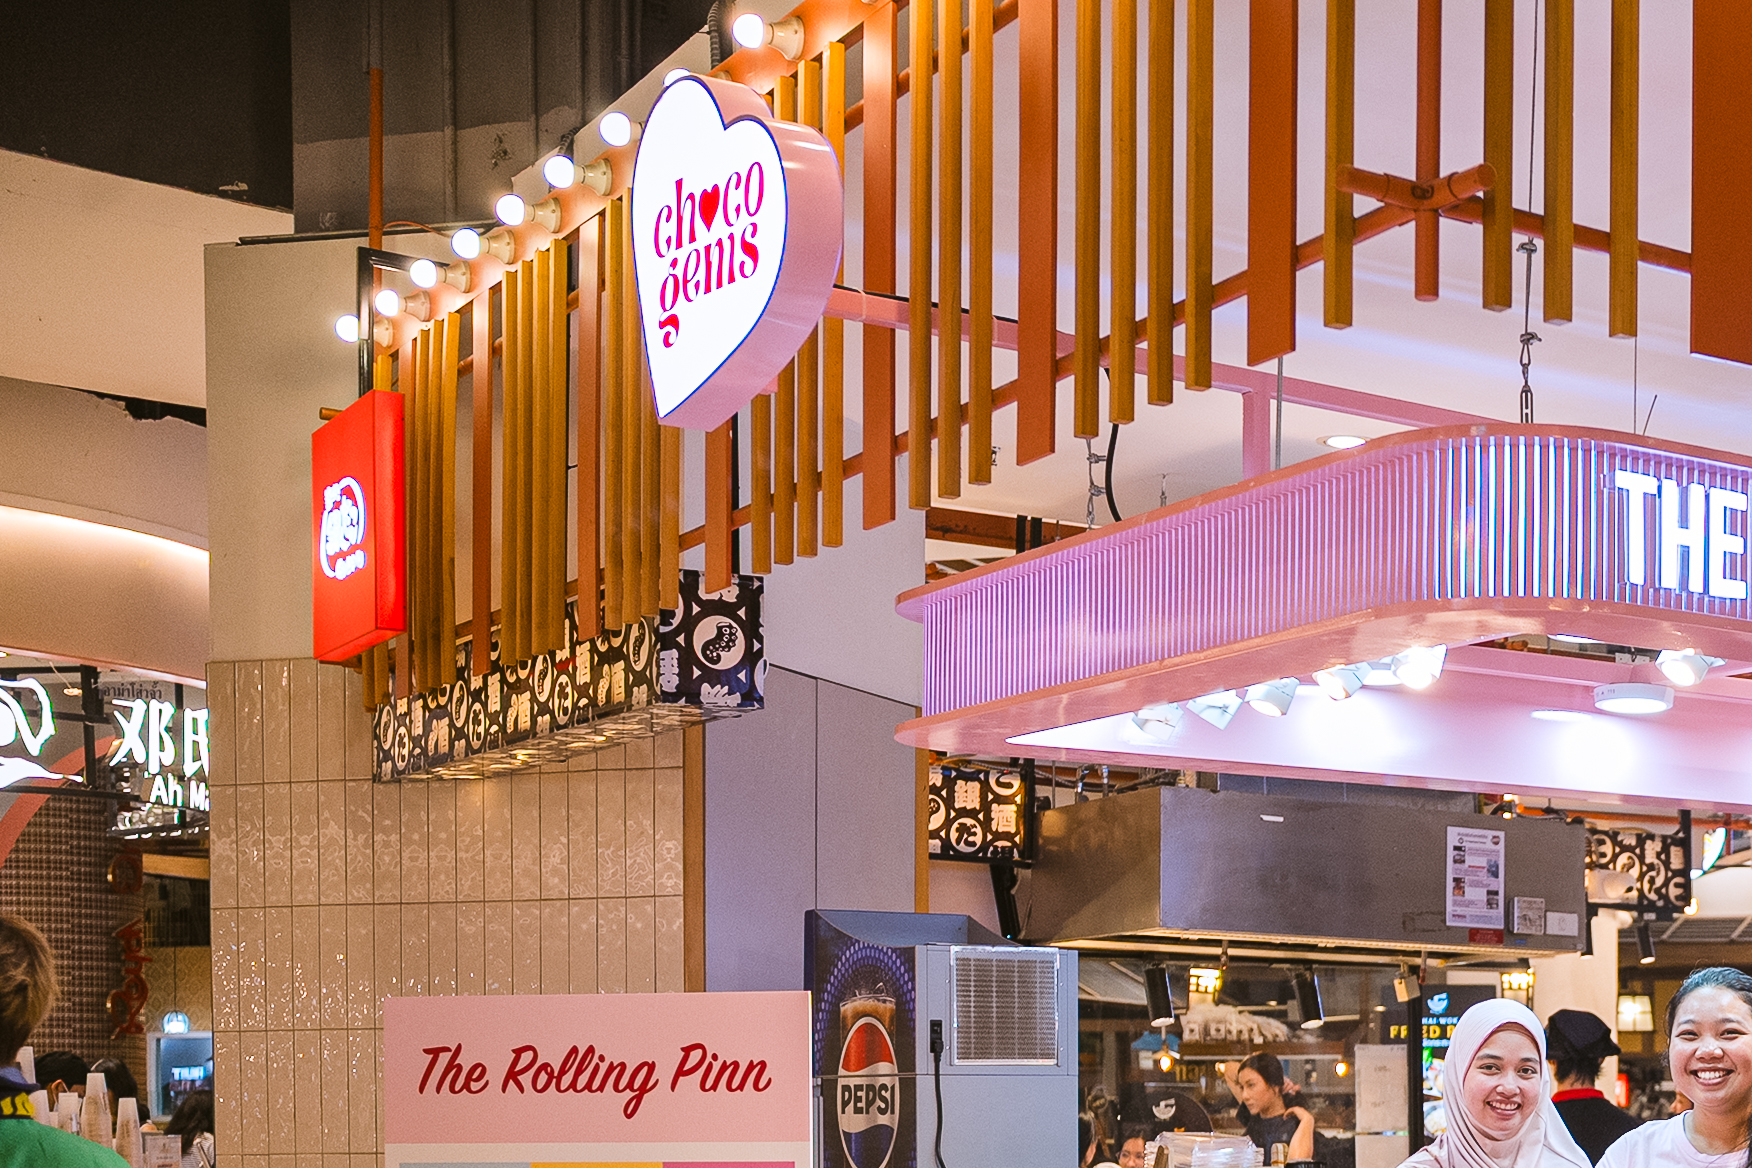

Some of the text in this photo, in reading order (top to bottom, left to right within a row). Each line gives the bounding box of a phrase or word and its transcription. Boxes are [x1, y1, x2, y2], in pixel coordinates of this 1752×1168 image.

[659, 222, 759, 348] gems
[1614, 471, 1748, 599] THE
[150, 773, 209, 811] Ah M
[418, 1043, 772, 1120] The Rolling Pinn
[841, 1083, 895, 1116] PEPSI
